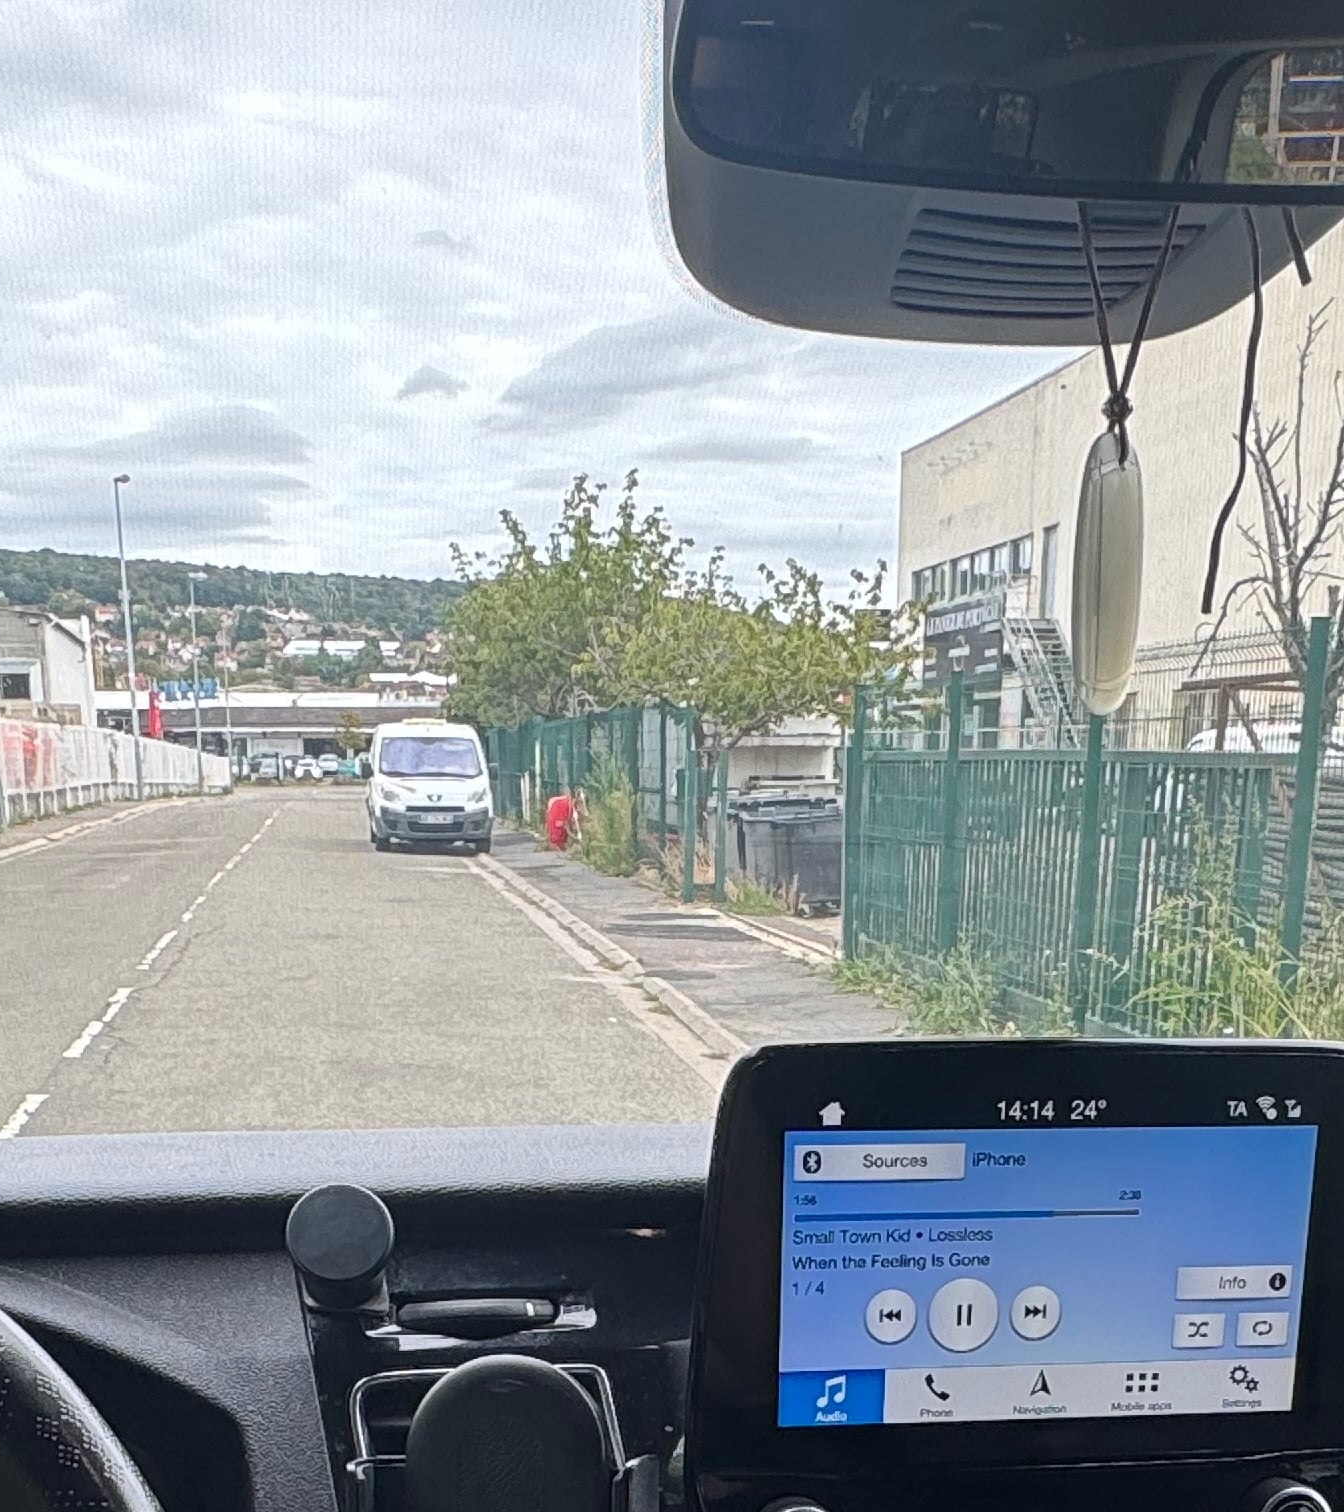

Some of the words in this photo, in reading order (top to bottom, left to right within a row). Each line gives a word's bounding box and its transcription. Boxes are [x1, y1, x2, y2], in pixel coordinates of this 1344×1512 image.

[997, 1100, 1056, 1121] 14:14
[1070, 1099, 1107, 1121] 24°
[1227, 1100, 1248, 1118] TA
[862, 1152, 928, 1169] Sources
[972, 1151, 1026, 1168] iPhone
[792, 1229, 835, 1246] Small
[839, 1228, 882, 1245] Town
[886, 1227, 911, 1243] Kid
[928, 1226, 994, 1243] Lossless
[792, 1256, 838, 1271] When
[842, 1255, 867, 1270] the
[871, 1253, 927, 1272] Feeling
[931, 1252, 945, 1267] Is
[948, 1252, 991, 1268] Gone
[1218, 1275, 1248, 1291] Info
[1012, 1403, 1068, 1417] Navigation
[1110, 1401, 1145, 1412] Mobile
[1147, 1402, 1173, 1412] apps
[1221, 1398, 1263, 1410] Settings
[814, 1410, 848, 1424] Audio
[919, 1407, 954, 1419] Phone
